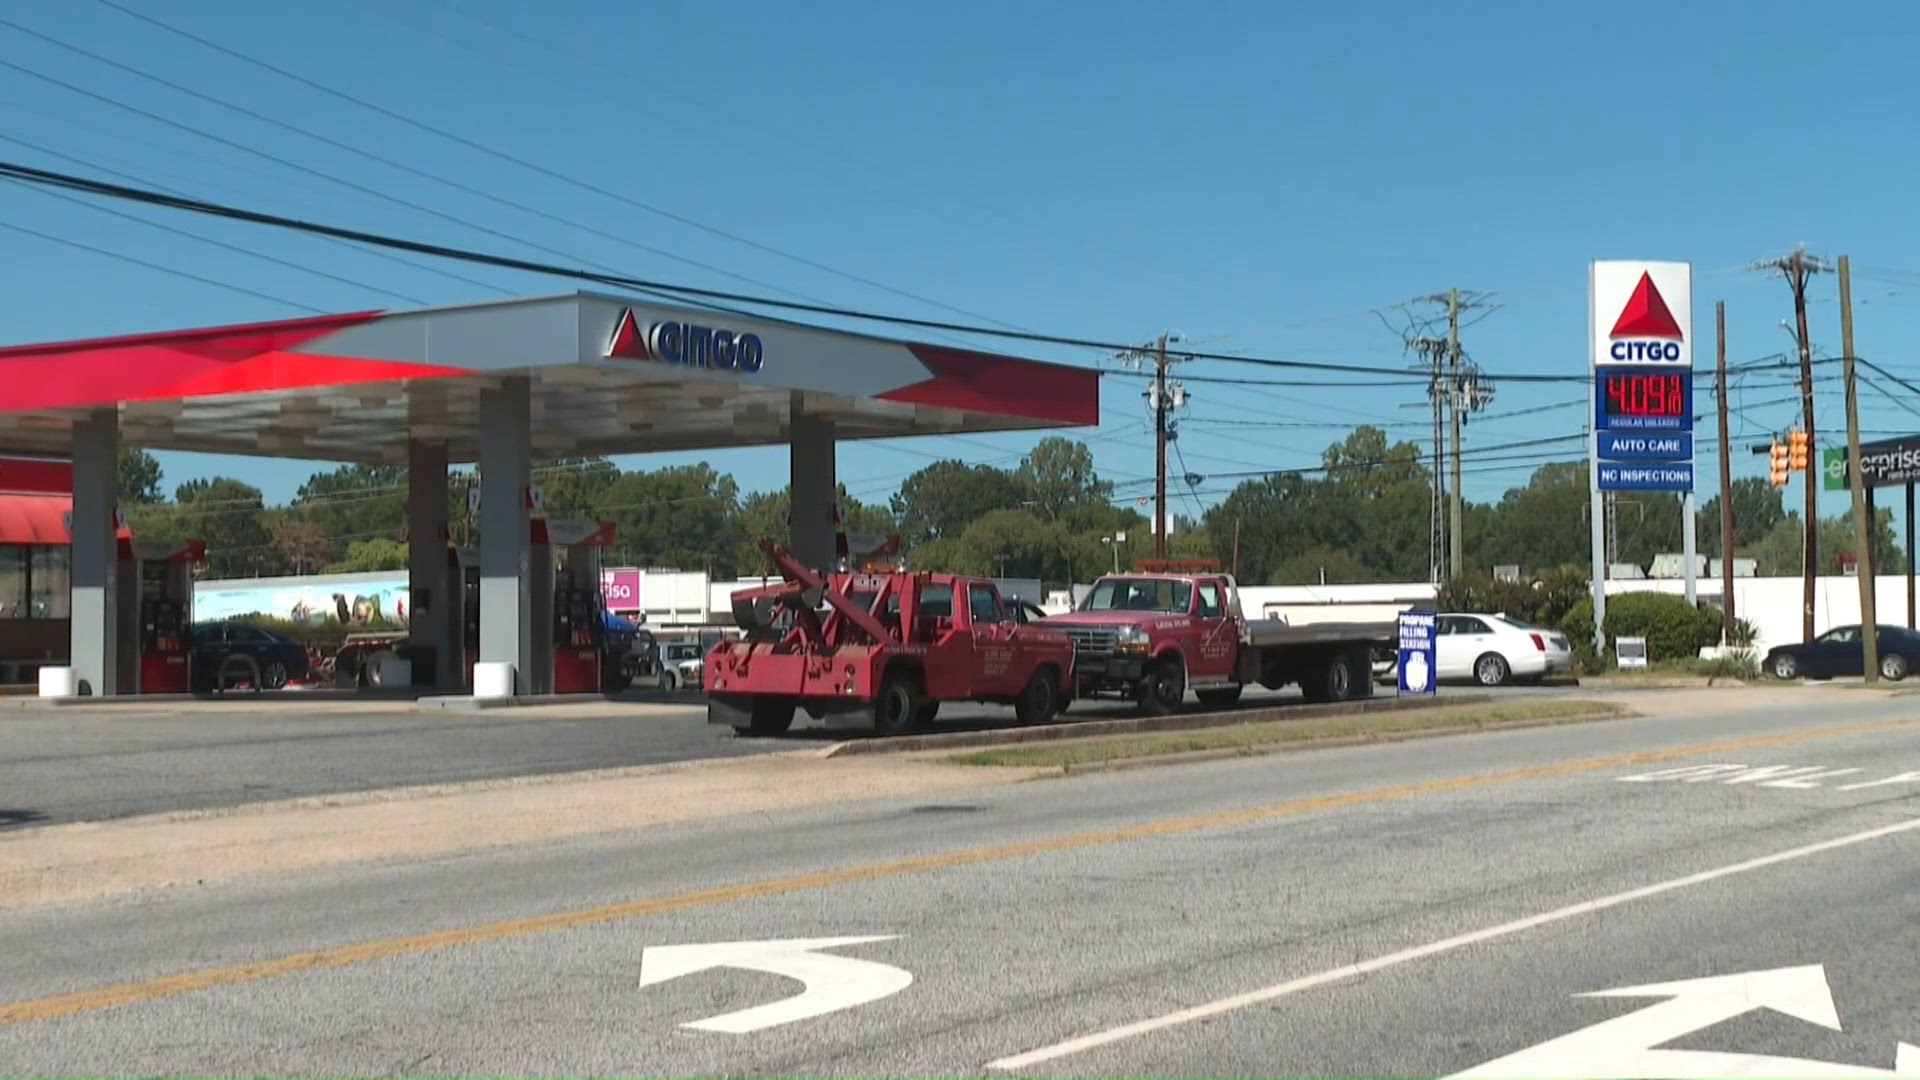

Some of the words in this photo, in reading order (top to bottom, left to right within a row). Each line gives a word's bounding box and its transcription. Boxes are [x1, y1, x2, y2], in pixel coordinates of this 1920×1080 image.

[652, 321, 764, 373] CITGO
[1610, 342, 1680, 361] CITGO
[1612, 439, 1645, 452] AUTO
[1648, 439, 1680, 452] CARE
[1825, 444, 1920, 478] eerprise
[1620, 469, 1690, 482] INSPECTIONS
[1400, 614, 1434, 626] PROPANE
[1400, 626, 1428, 638] FILLING
[1400, 639, 1431, 650] STATION
